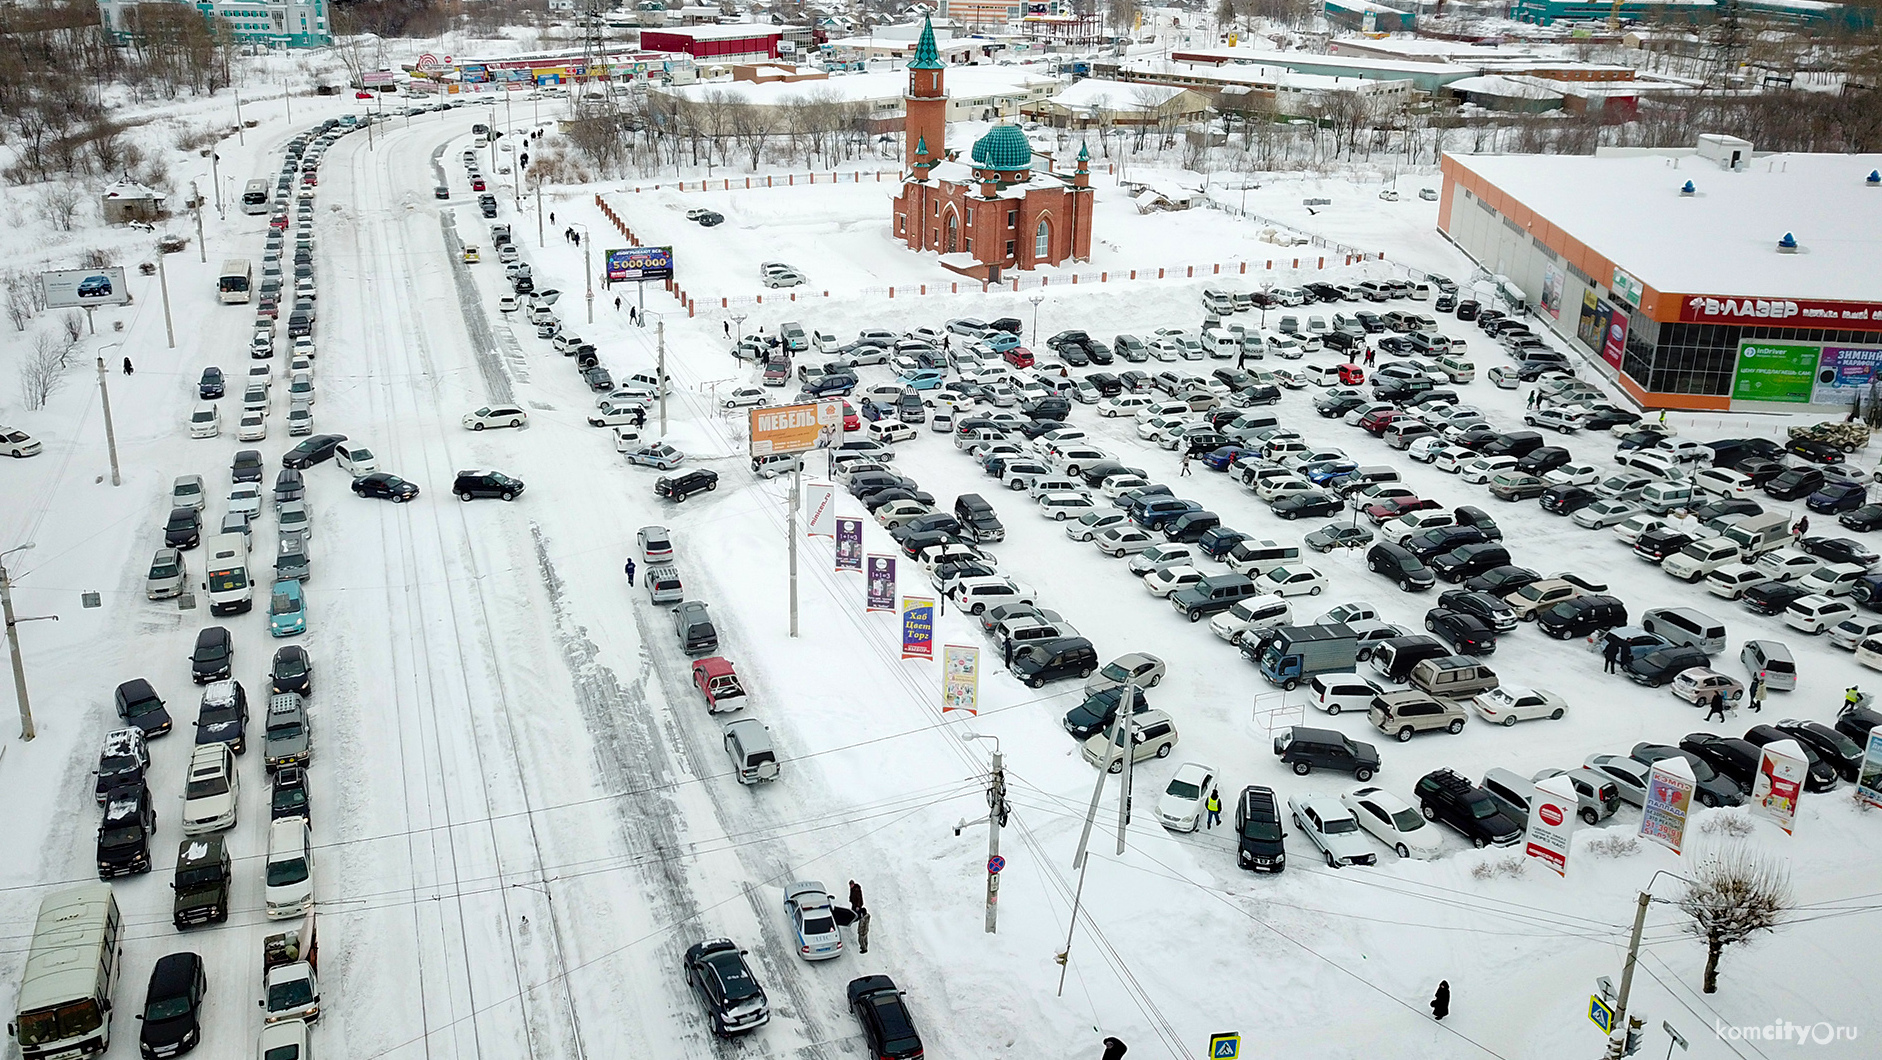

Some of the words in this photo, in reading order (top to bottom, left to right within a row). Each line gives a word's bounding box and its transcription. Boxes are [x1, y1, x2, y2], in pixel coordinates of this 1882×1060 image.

[613, 261, 620, 270] 5
[621, 260, 643, 269] 000
[644, 258, 667, 268] 000
[758, 411, 816, 432] МЕБЕЛЬ
[810, 492, 832, 527] minicen.ru
[910, 611, 928, 621] Хаб
[906, 621, 931, 630] Цвет
[908, 630, 929, 641] Торг
[1648, 800, 1685, 818] ПАЛЛАДА
